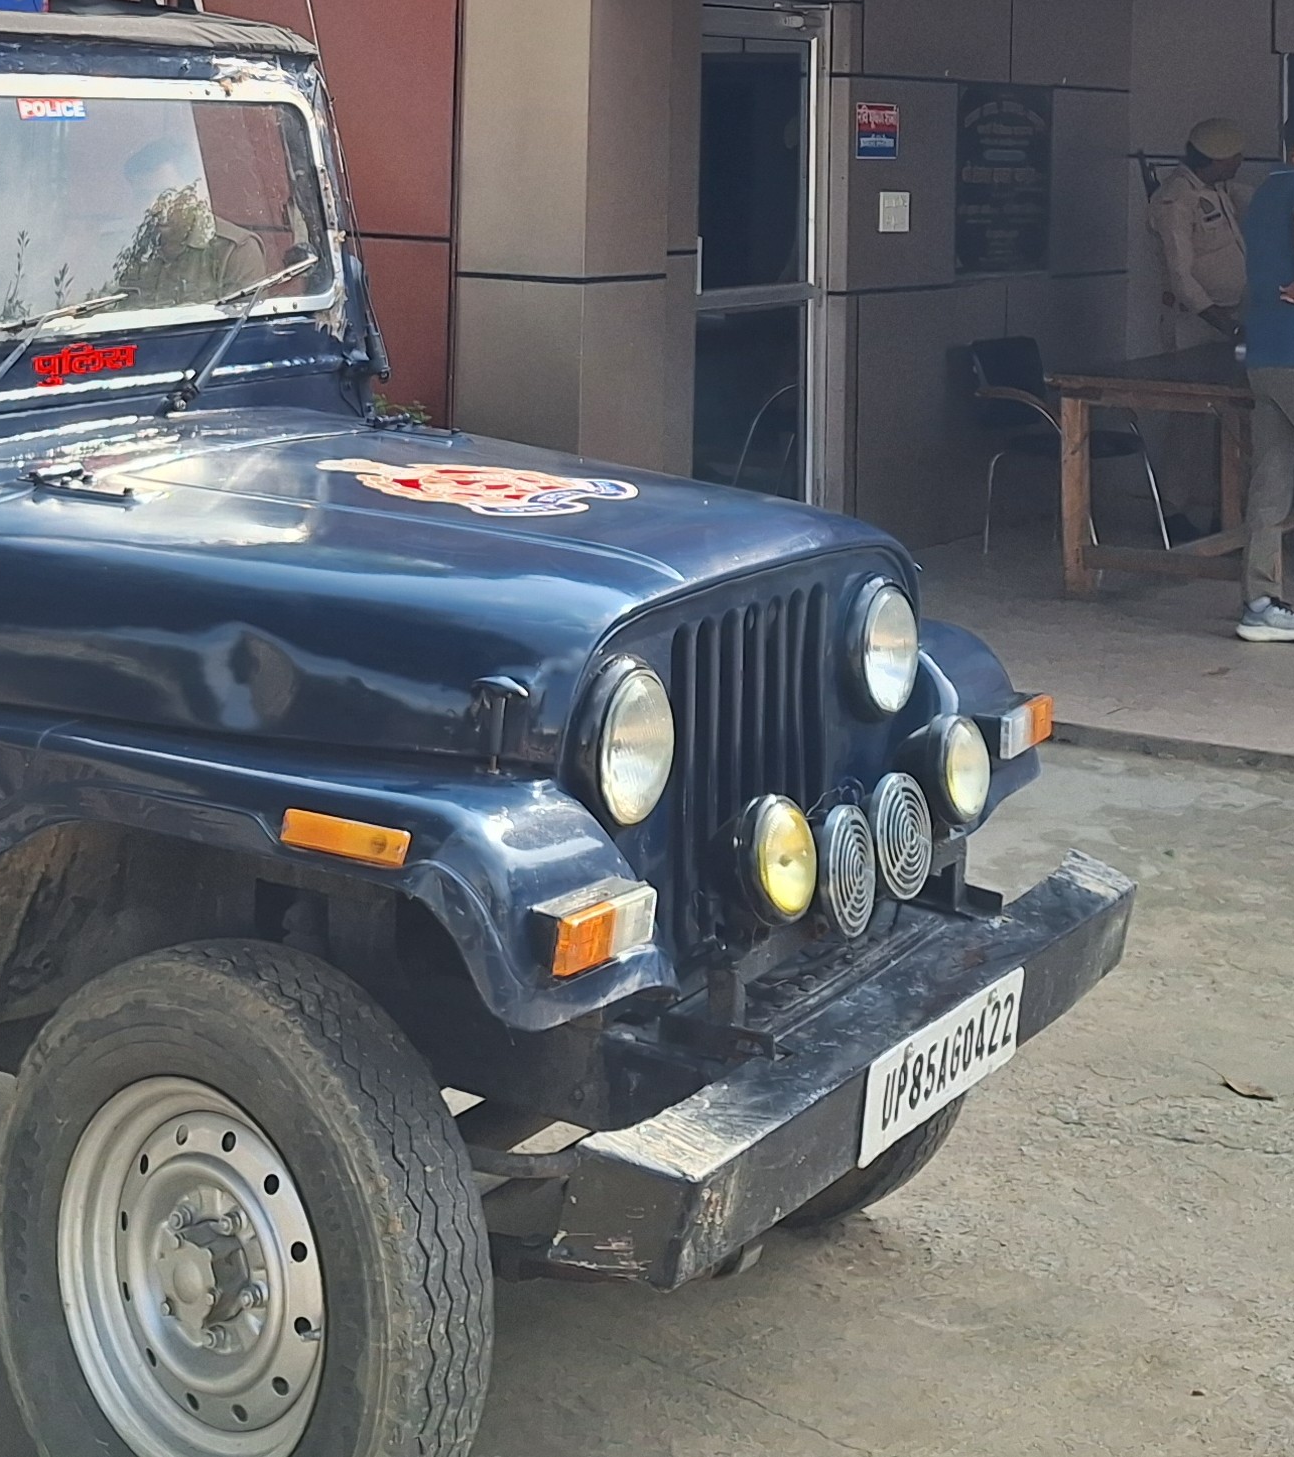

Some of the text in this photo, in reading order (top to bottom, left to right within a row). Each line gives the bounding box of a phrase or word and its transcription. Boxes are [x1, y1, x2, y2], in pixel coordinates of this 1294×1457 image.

[19, 99, 86, 119] POLICE
[31, 342, 138, 387] पुलिस
[881, 992, 1015, 1131] UP85AG0422
